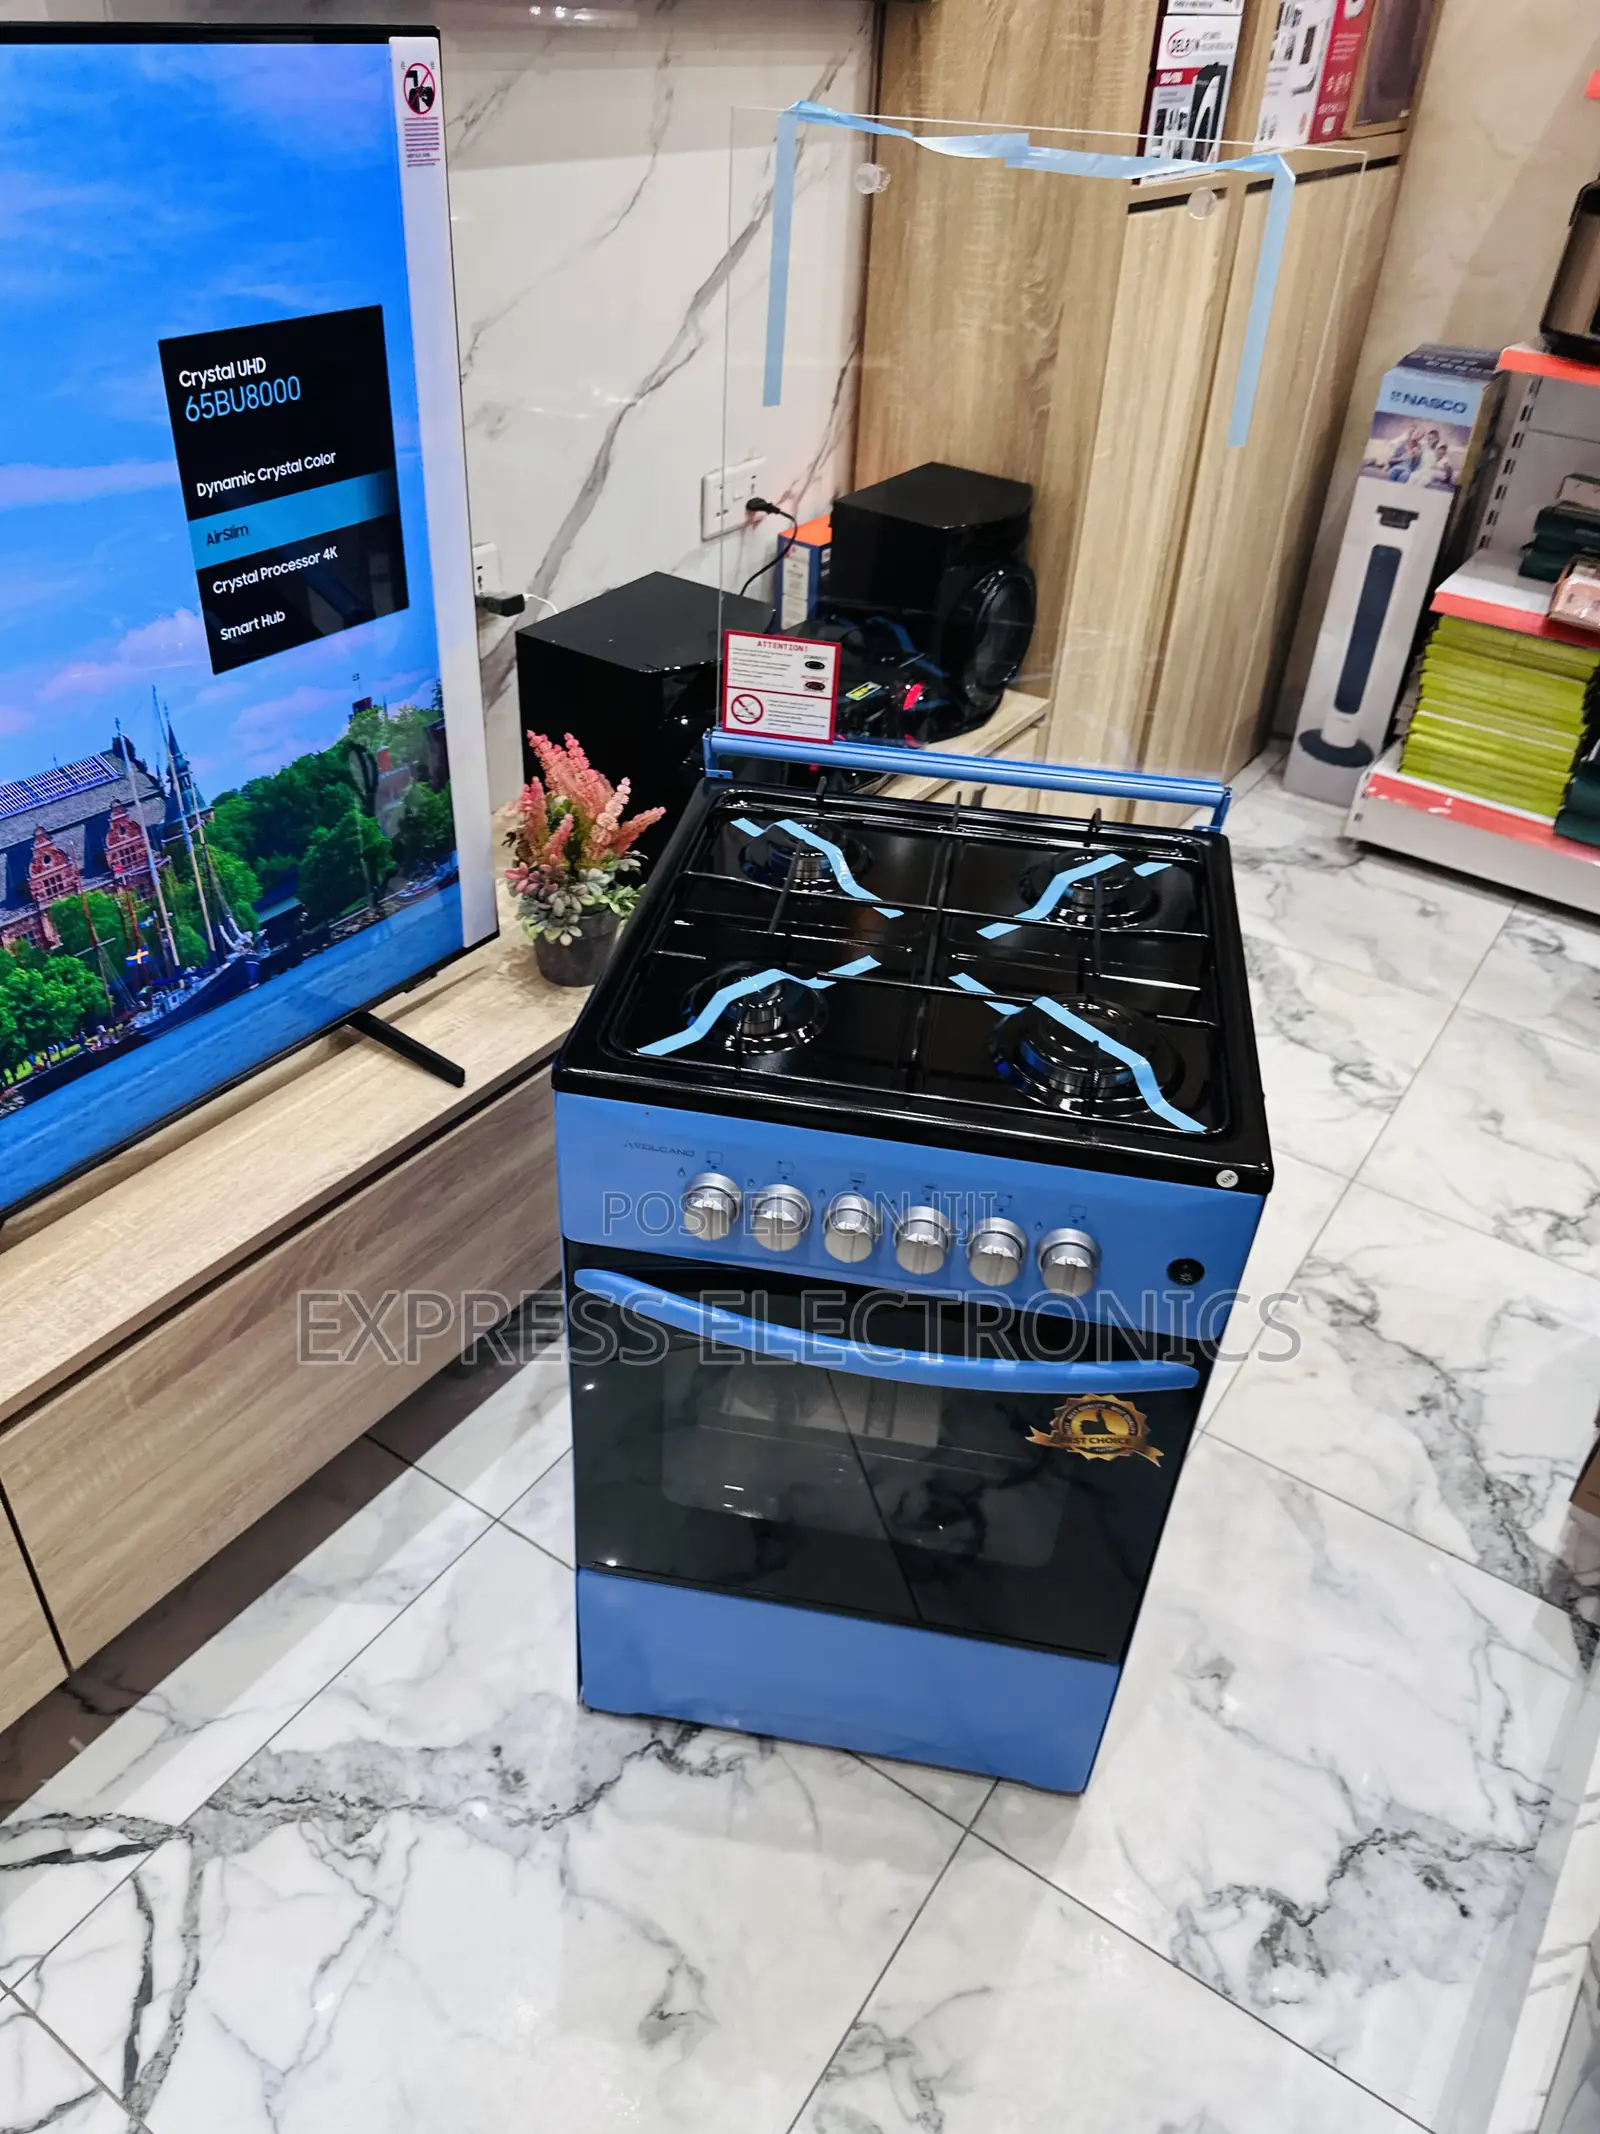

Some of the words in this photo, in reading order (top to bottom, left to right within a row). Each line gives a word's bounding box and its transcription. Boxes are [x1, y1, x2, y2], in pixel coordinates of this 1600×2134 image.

[179, 362, 235, 389] Crystal
[237, 357, 267, 376] UHD
[185, 375, 301, 422] 65BU8000
[1402, 393, 1468, 413] NASCO
[196, 471, 256, 498] Dynamic
[257, 459, 303, 481] Crystal
[304, 452, 336, 469] Color
[206, 524, 249, 546] AirSlim
[212, 569, 259, 594] Crystal
[260, 552, 321, 581] Processor
[322, 546, 338, 561] 4K
[220, 617, 260, 641] Smart
[261, 610, 286, 628] Hub
[756, 640, 809, 653] ATTENTION!
[1089, 1437, 1129, 1445] CHOICE
